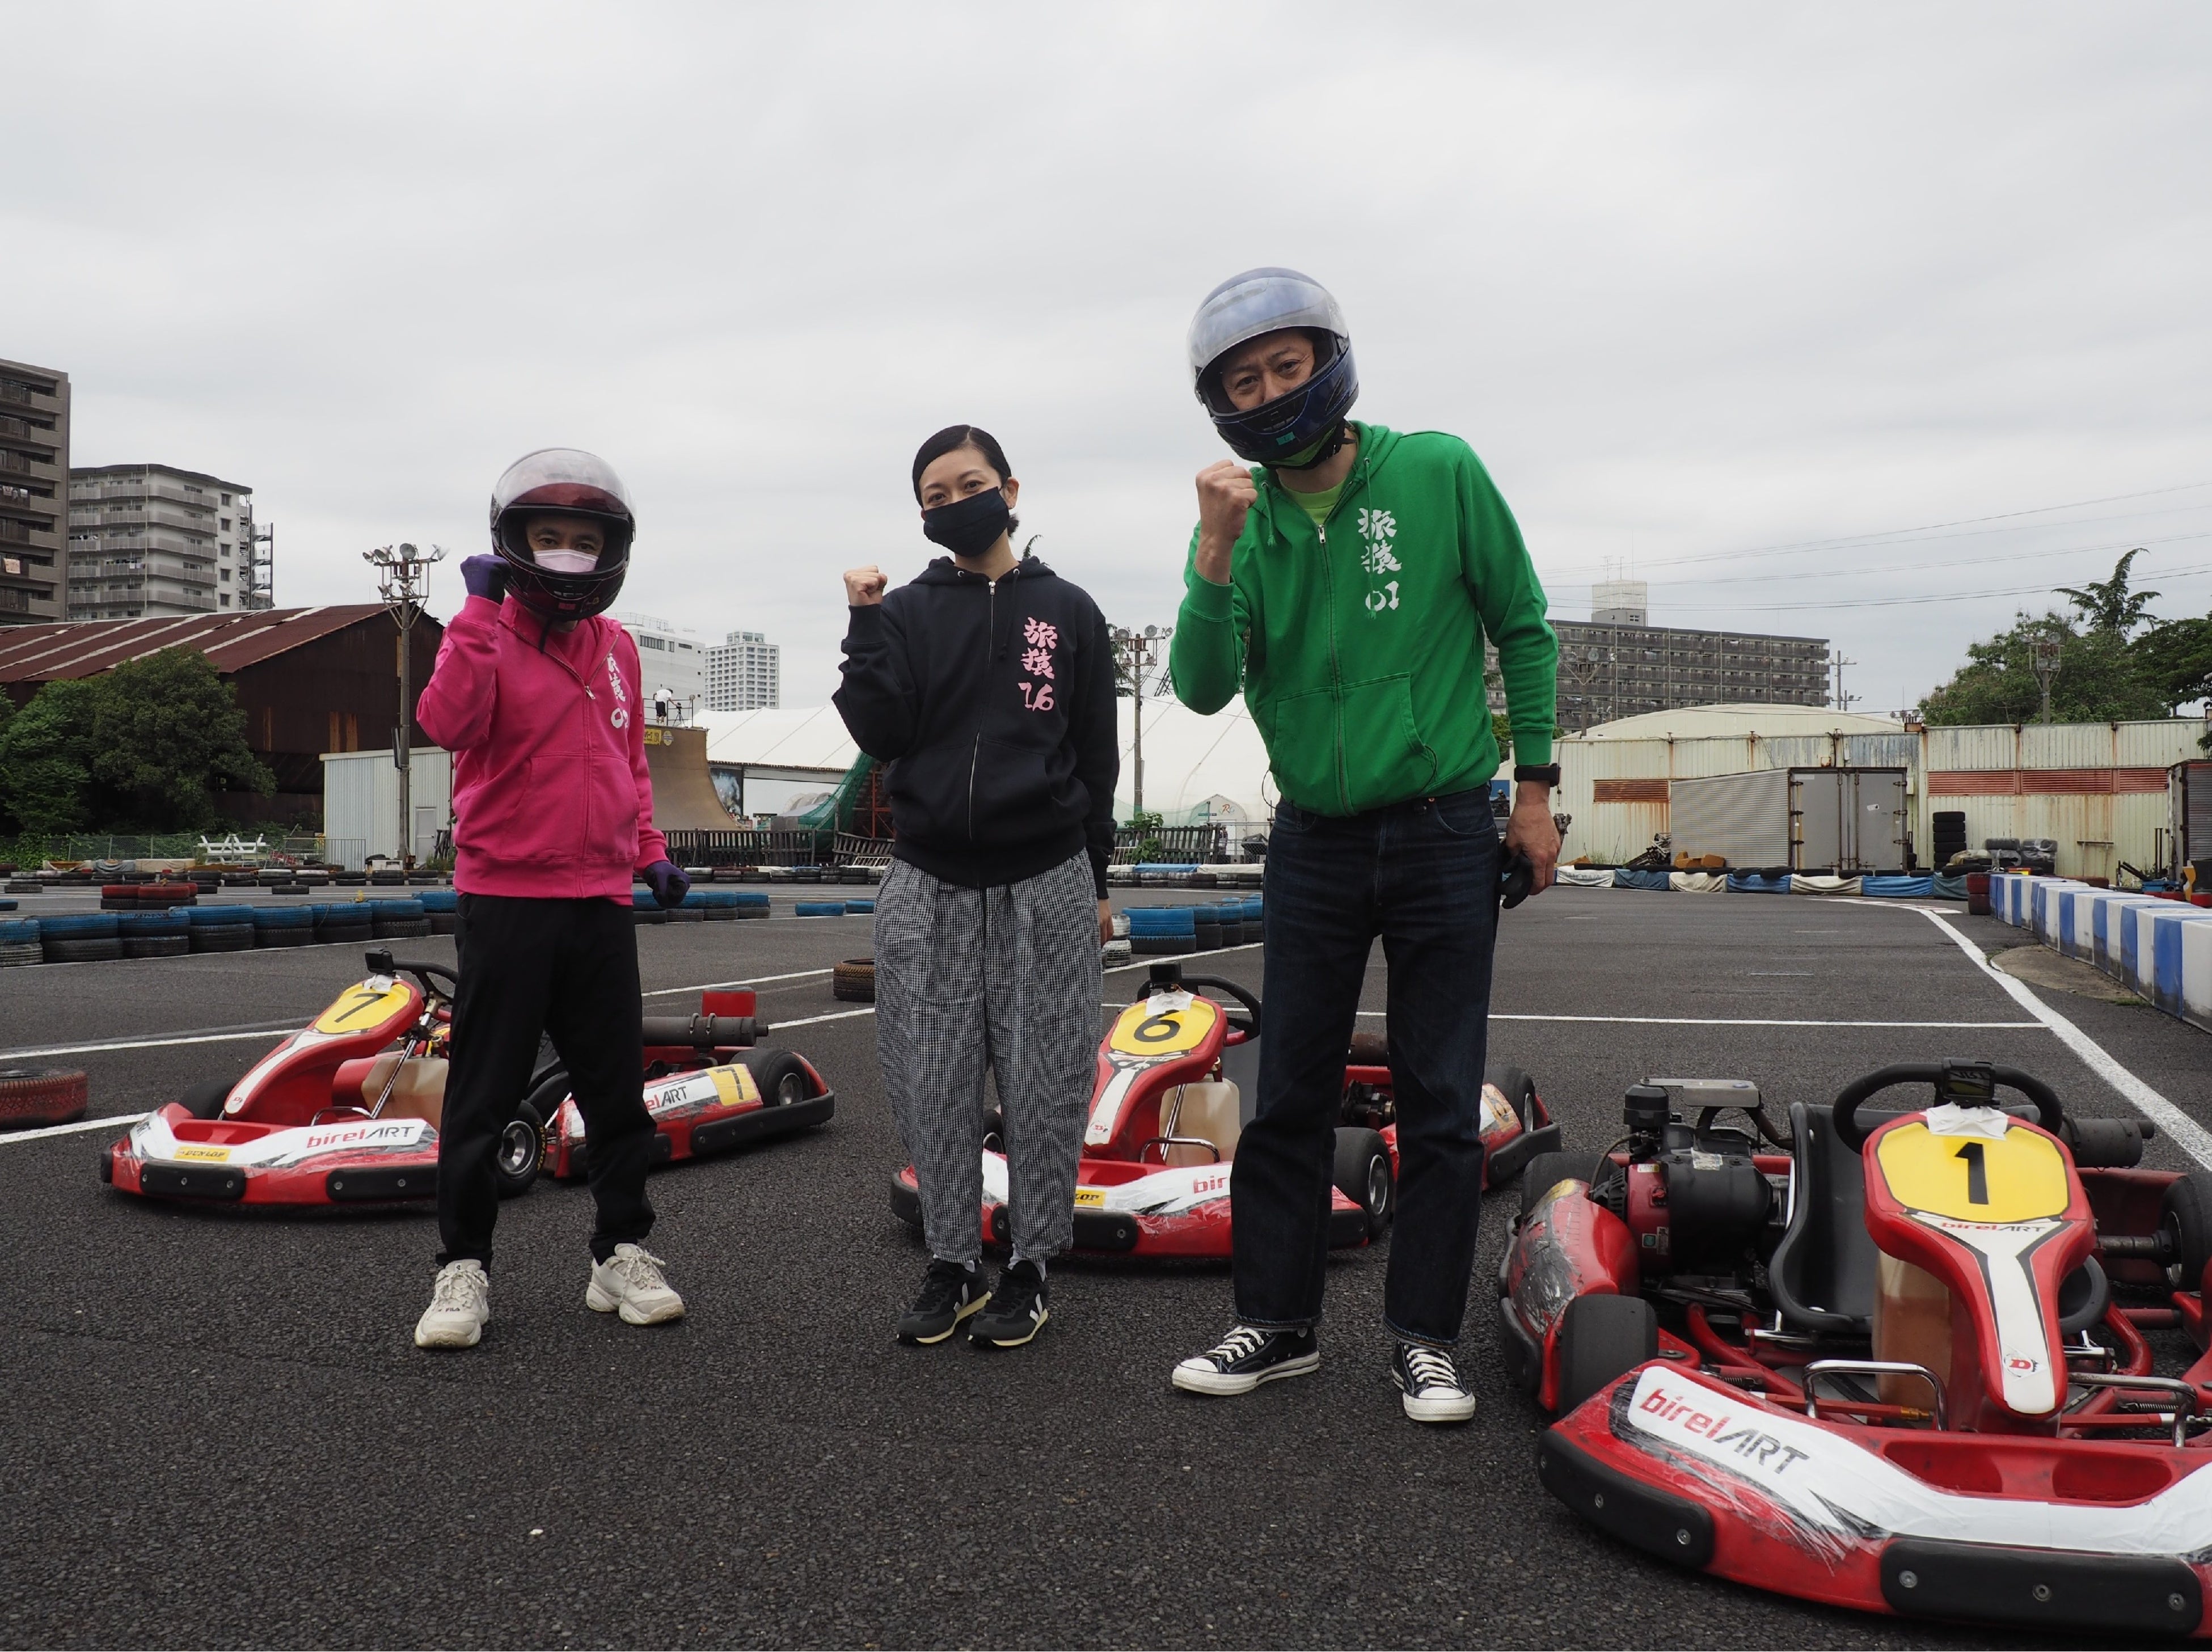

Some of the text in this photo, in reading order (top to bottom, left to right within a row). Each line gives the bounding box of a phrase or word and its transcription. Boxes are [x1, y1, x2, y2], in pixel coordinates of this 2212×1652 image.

[1018, 616, 1057, 711] 旅猿 16
[334, 992, 388, 1023] 7
[1133, 1009, 1180, 1042] 6
[714, 1067, 744, 1100] 7
[307, 1126, 415, 1148] birelART
[1954, 1142, 1989, 1205] 1
[1639, 1388, 1810, 1474] birelART
